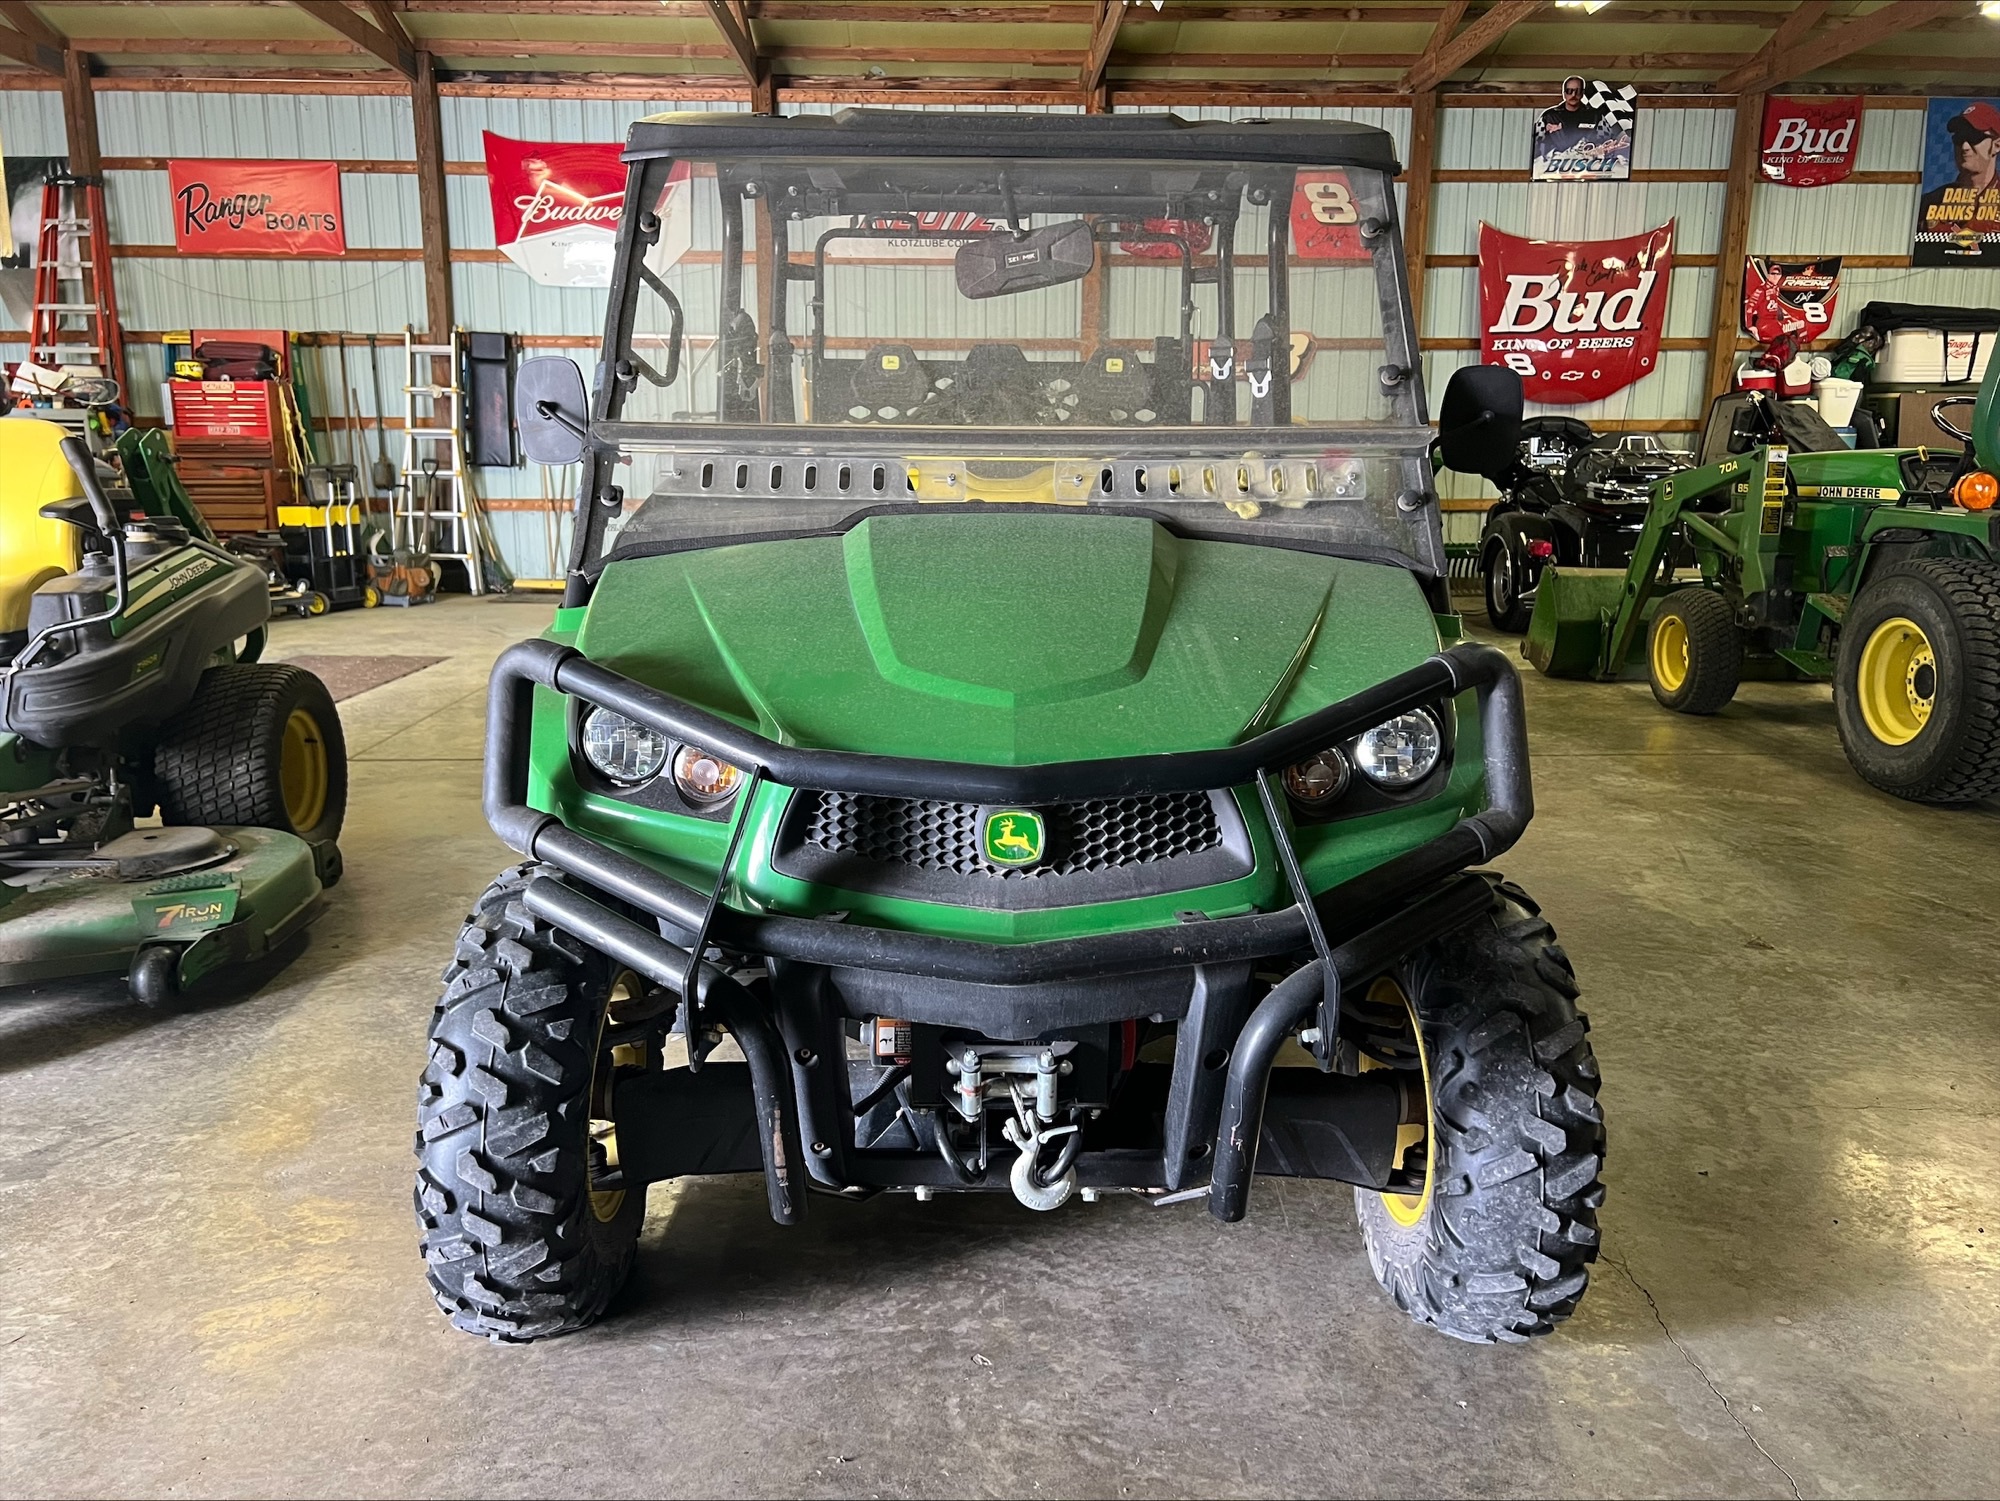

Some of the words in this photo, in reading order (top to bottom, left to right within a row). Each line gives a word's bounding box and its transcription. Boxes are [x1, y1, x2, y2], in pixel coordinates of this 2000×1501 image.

[1763, 118, 1856, 153] Bud
[1544, 159, 1619, 173] BUSCH
[1942, 188, 1978, 203] DALE
[177, 183, 271, 235] Ranger
[1926, 205, 1975, 220] BANKS
[266, 213, 336, 231] BOATS
[1489, 271, 1658, 333] Bud
[1802, 302, 1828, 322] 8
[1546, 339, 1572, 349] OF
[1577, 337, 1635, 349] BEERS
[1503, 353, 1536, 376] 8
[1719, 461, 1738, 474] 70A
[1817, 486, 1844, 497] JOHN
[1846, 488, 1881, 498] DEERE
[168, 572, 188, 590] JOHN
[186, 560, 209, 581] DEERE
